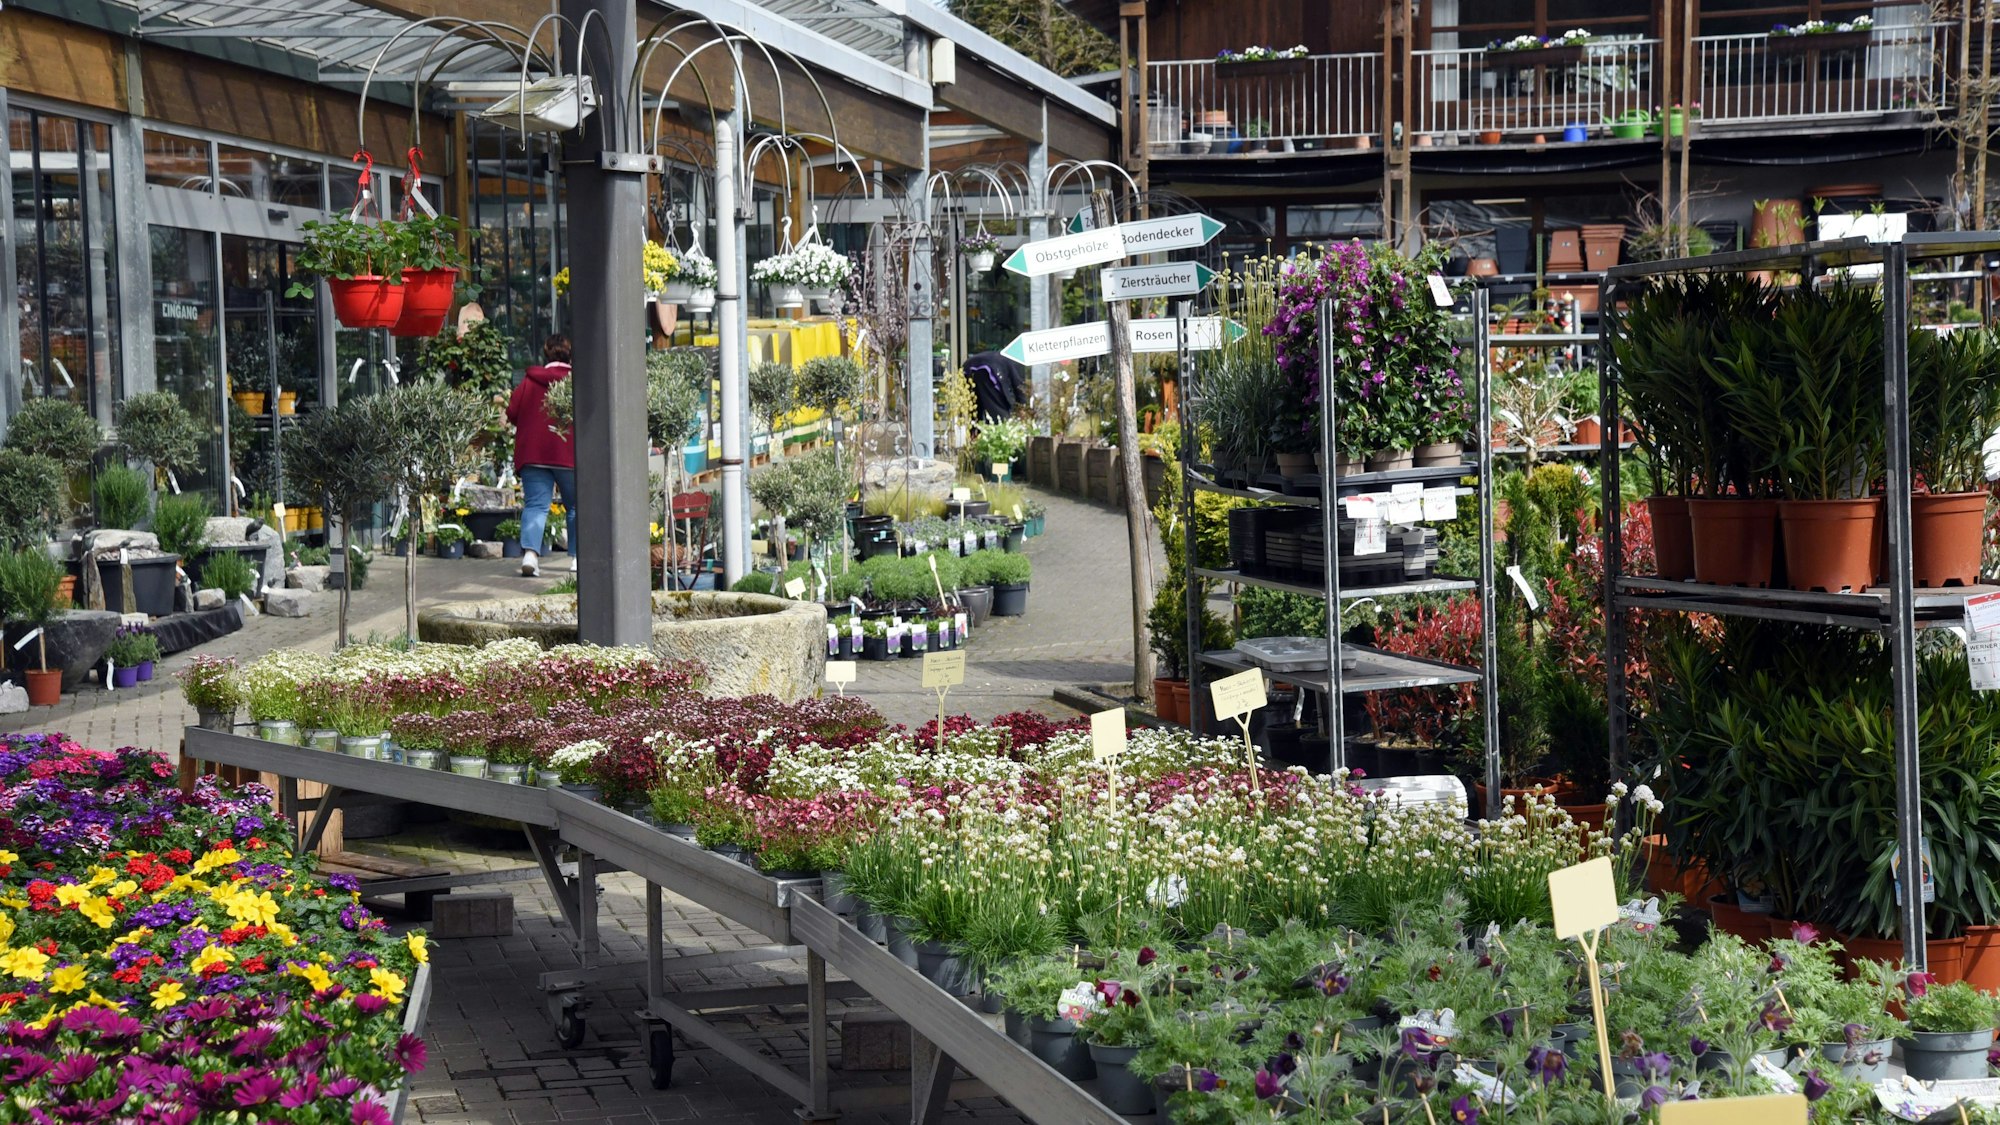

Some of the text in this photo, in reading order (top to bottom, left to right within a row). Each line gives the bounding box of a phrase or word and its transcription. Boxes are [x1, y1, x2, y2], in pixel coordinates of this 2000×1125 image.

[1122, 227, 1194, 245] Bodendecker
[1035, 240, 1109, 263] Obstgehölze
[1121, 273, 1192, 288] Ziersträucher
[162, 302, 198, 320] EINGANG
[1028, 332, 1107, 353] Kletterpflanzen
[1136, 329, 1173, 341] Rosen
[1063, 990, 1089, 1005] ROCK
[1403, 1017, 1430, 1029] ROCK
